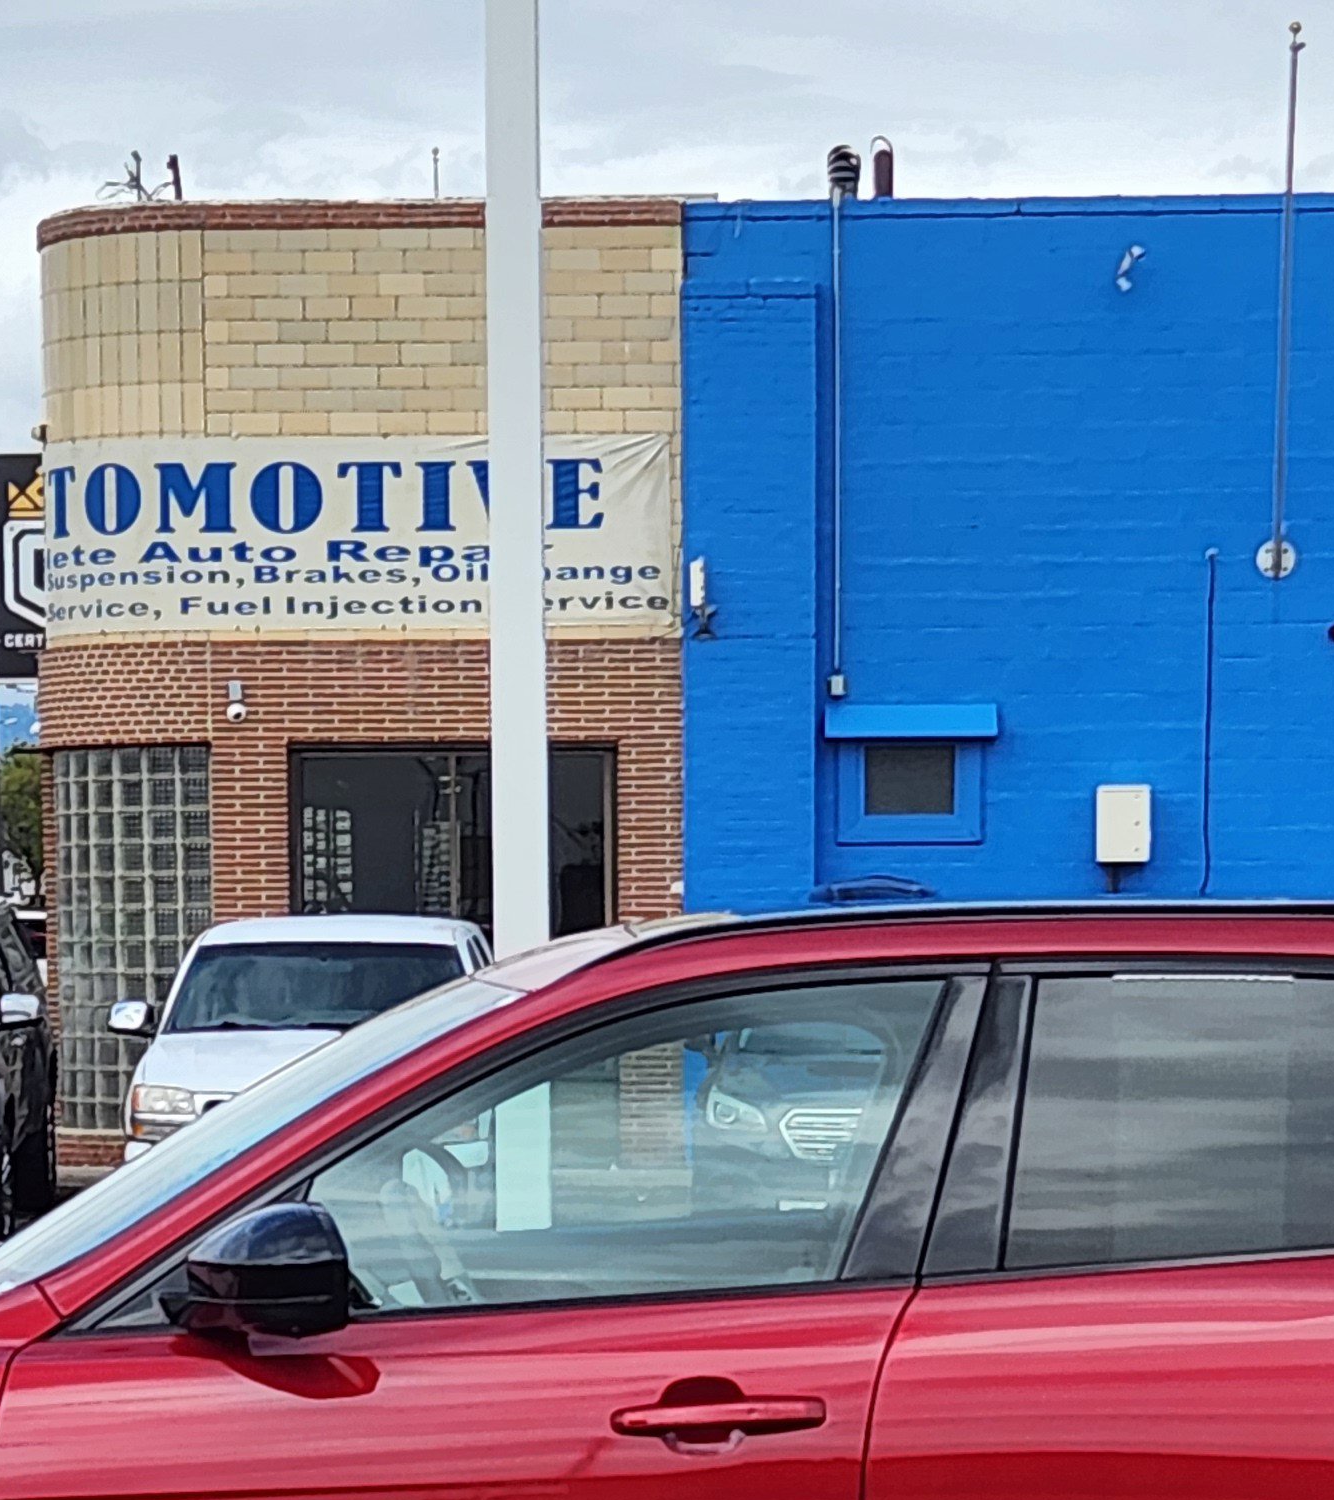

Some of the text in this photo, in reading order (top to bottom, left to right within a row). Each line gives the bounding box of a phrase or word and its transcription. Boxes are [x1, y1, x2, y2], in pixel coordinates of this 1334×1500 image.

[139, 541, 297, 564] Auto
[326, 540, 554, 567] Repa
[47, 563, 661, 593] Suspension, Brakes, Oil ange
[47, 601, 162, 622] Service,
[180, 596, 272, 615] Fuel
[286, 595, 482, 619] Injection
